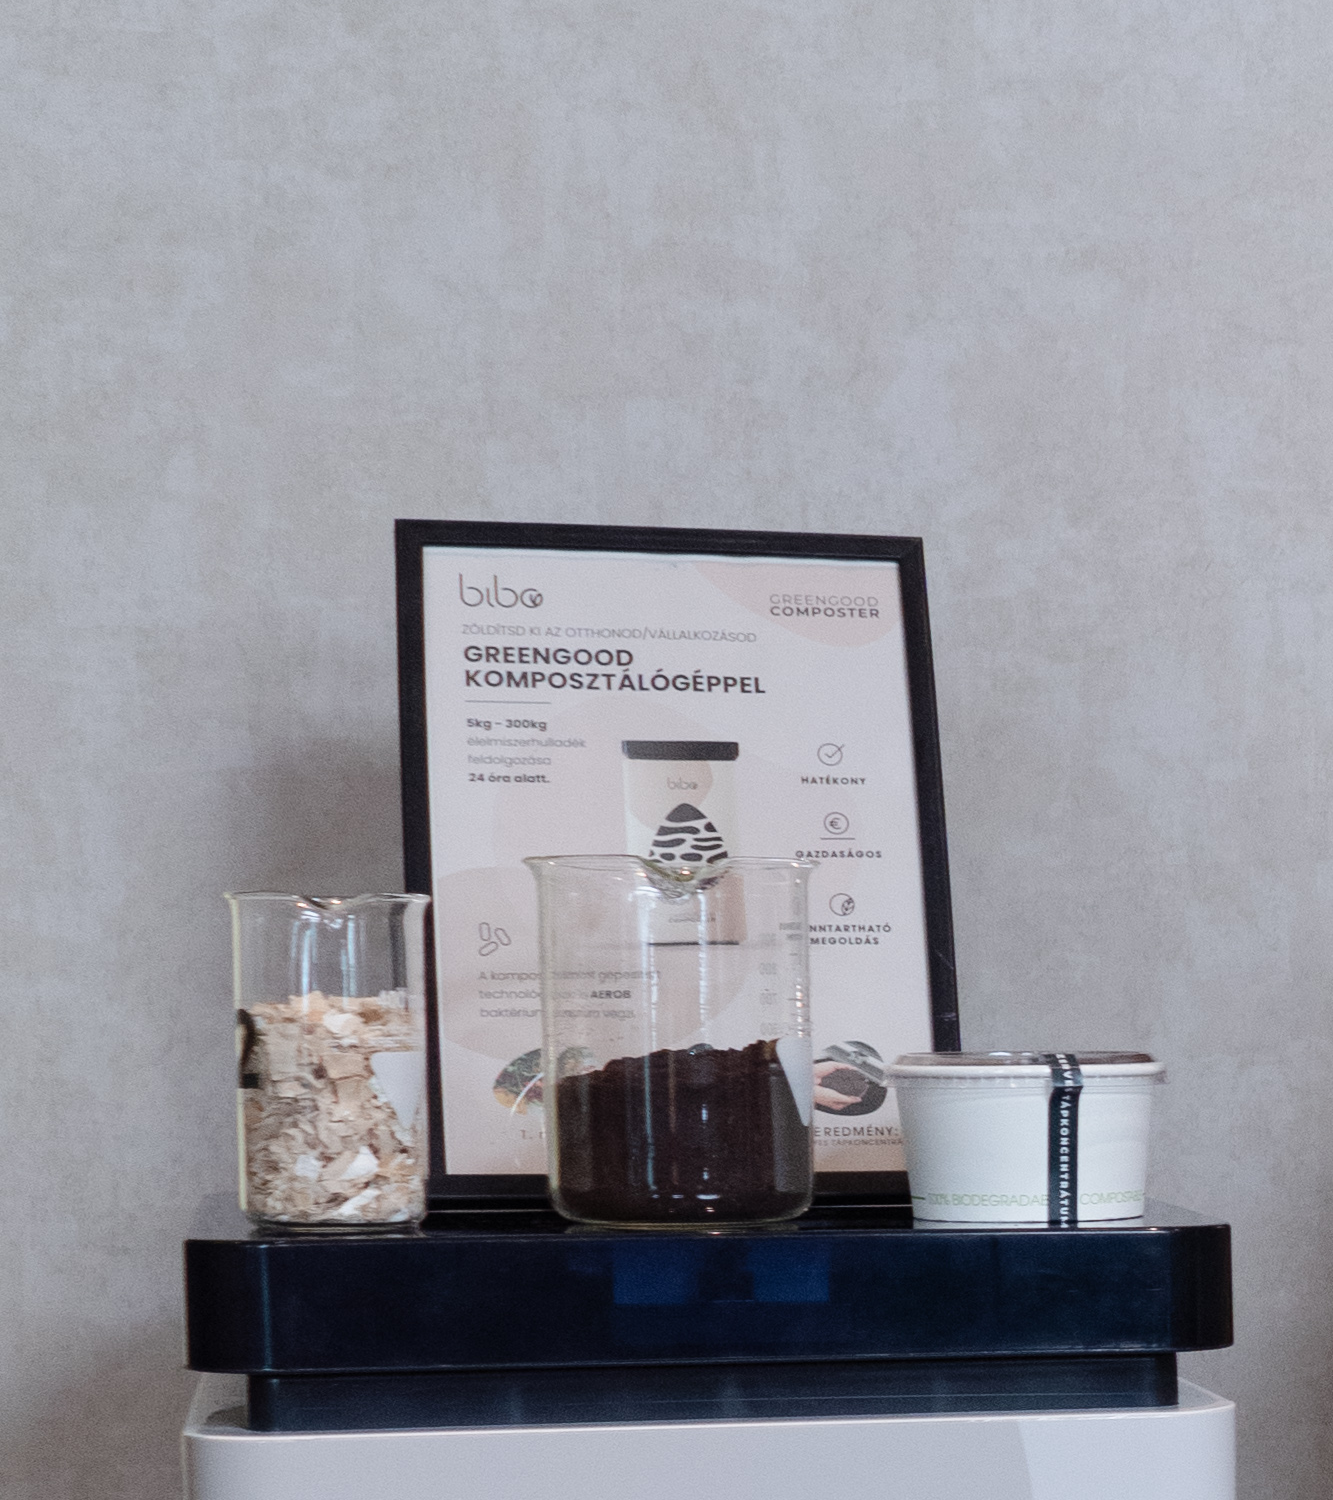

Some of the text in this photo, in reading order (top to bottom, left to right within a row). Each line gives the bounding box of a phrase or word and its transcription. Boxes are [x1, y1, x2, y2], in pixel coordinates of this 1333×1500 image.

[459, 573, 544, 609] bibo
[769, 594, 879, 607] GREENGOOD
[770, 606, 880, 618] COMPOSTER
[546, 627, 562, 637] AZ
[464, 645, 634, 667] GREENGOOD
[464, 668, 766, 694] KOMPOSZTÁLÓGÉPPEL
[467, 718, 492, 731] 5kg
[505, 719, 547, 731] 300kg
[468, 772, 551, 784] 24 óra alatt.
[800, 774, 867, 786] HATÉKONY
[795, 849, 882, 859] GAZDASÁGOS
[808, 922, 892, 933] NNTARTHATÓ
[809, 934, 880, 945] MEGOLDÁS
[590, 989, 632, 1000] AEROB
